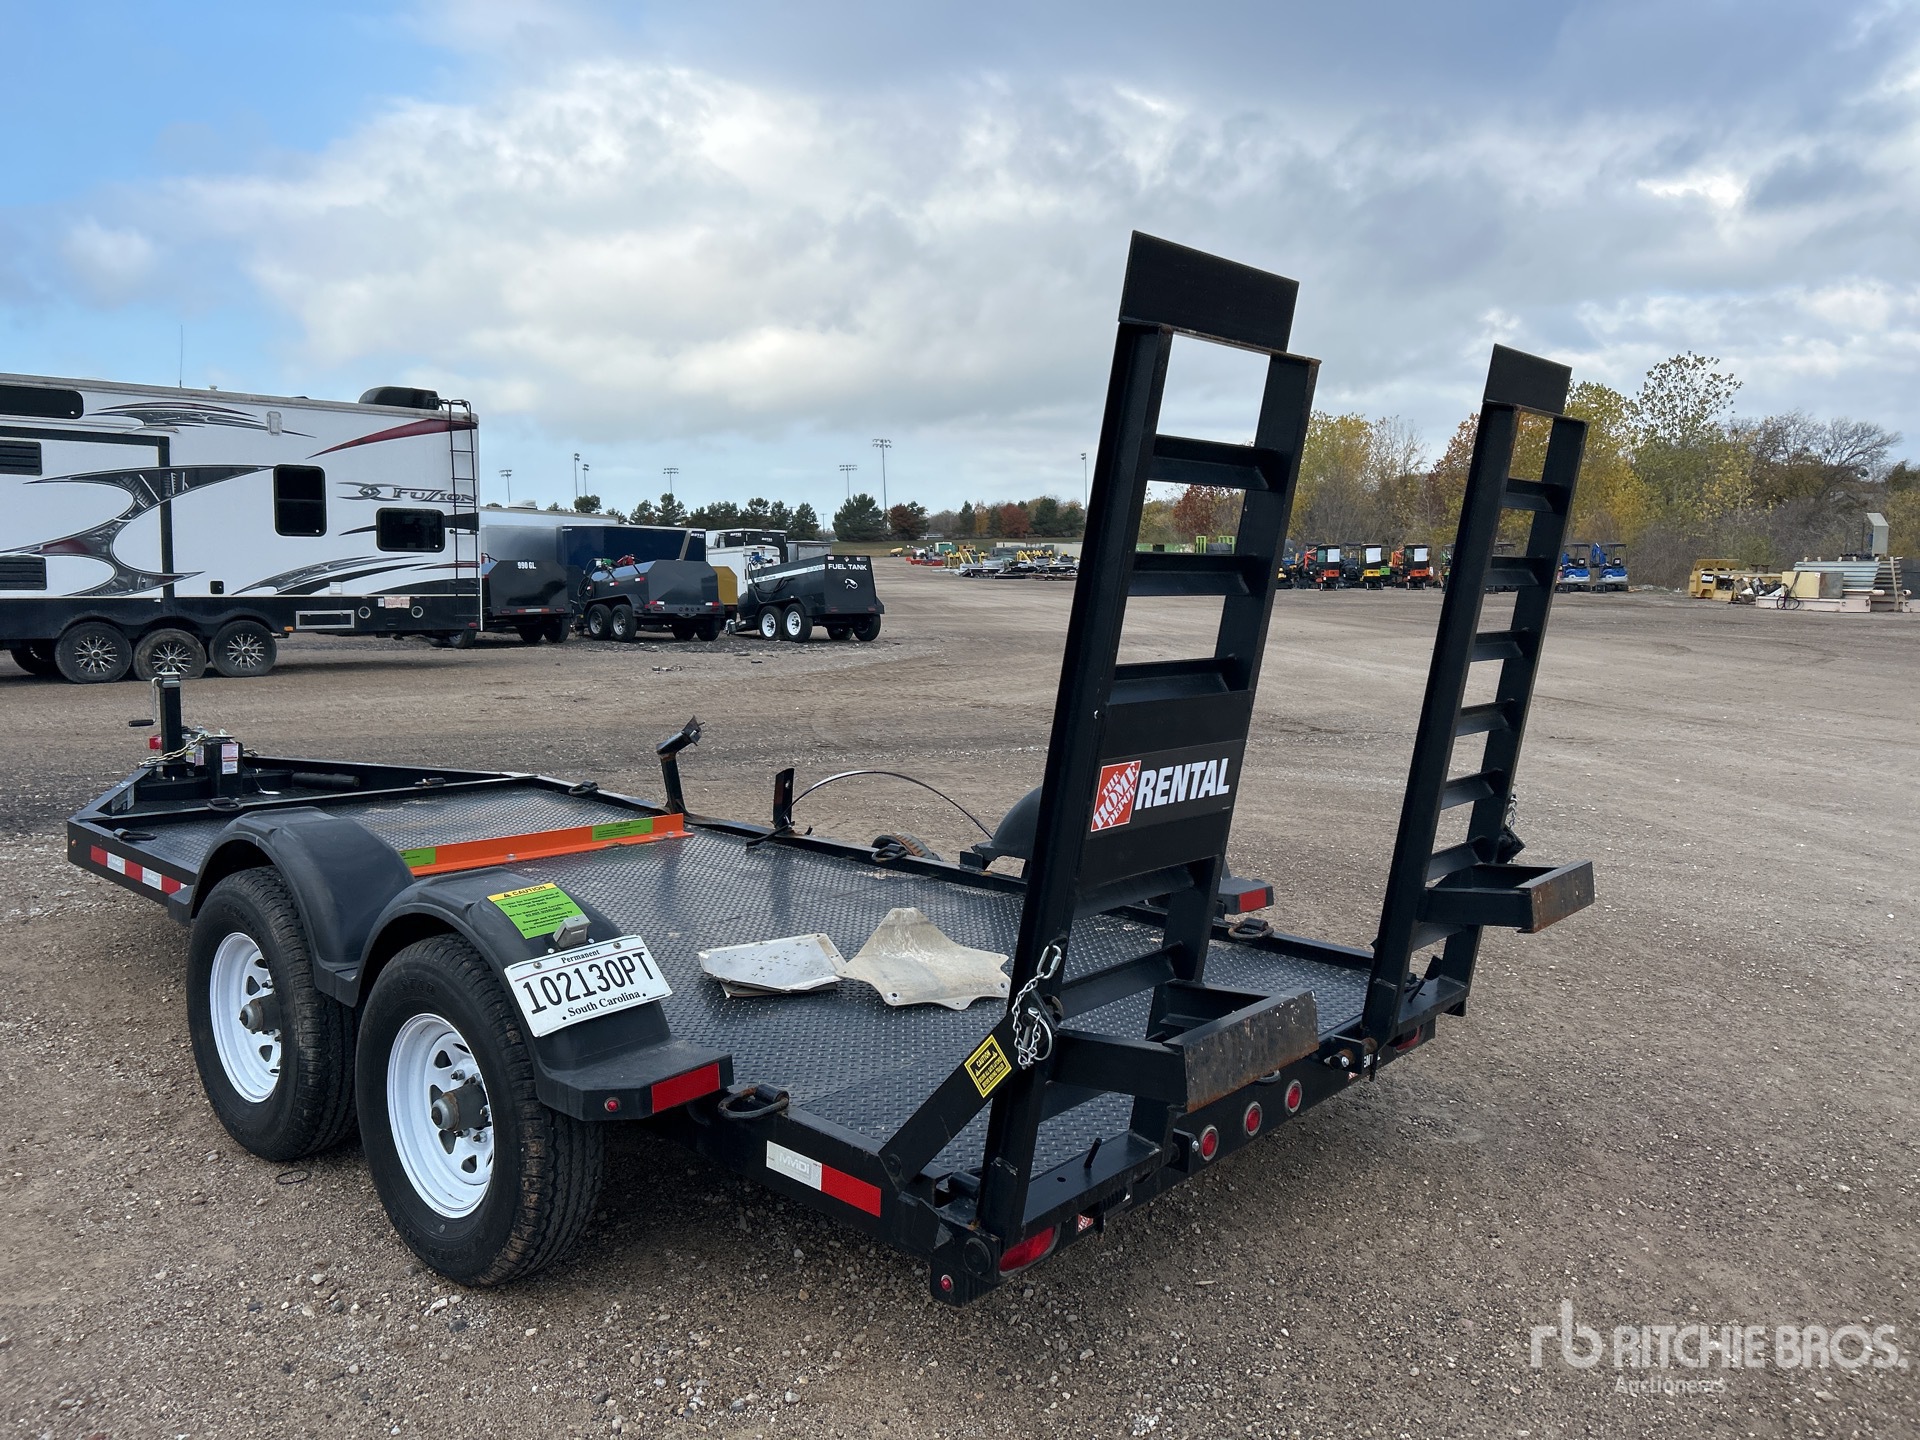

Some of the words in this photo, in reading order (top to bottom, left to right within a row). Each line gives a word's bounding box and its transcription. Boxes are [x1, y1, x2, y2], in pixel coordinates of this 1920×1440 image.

[847, 563, 868, 571] TANK
[1093, 762, 1139, 829] HOME
[1102, 771, 1121, 797] THE
[1134, 757, 1230, 811] RENTAL
[512, 885, 546, 896] CAUTION
[561, 949, 600, 964] Permanent
[523, 952, 654, 1014] 102130PT
[567, 1000, 598, 1017] South
[599, 991, 641, 1008] Carolina
